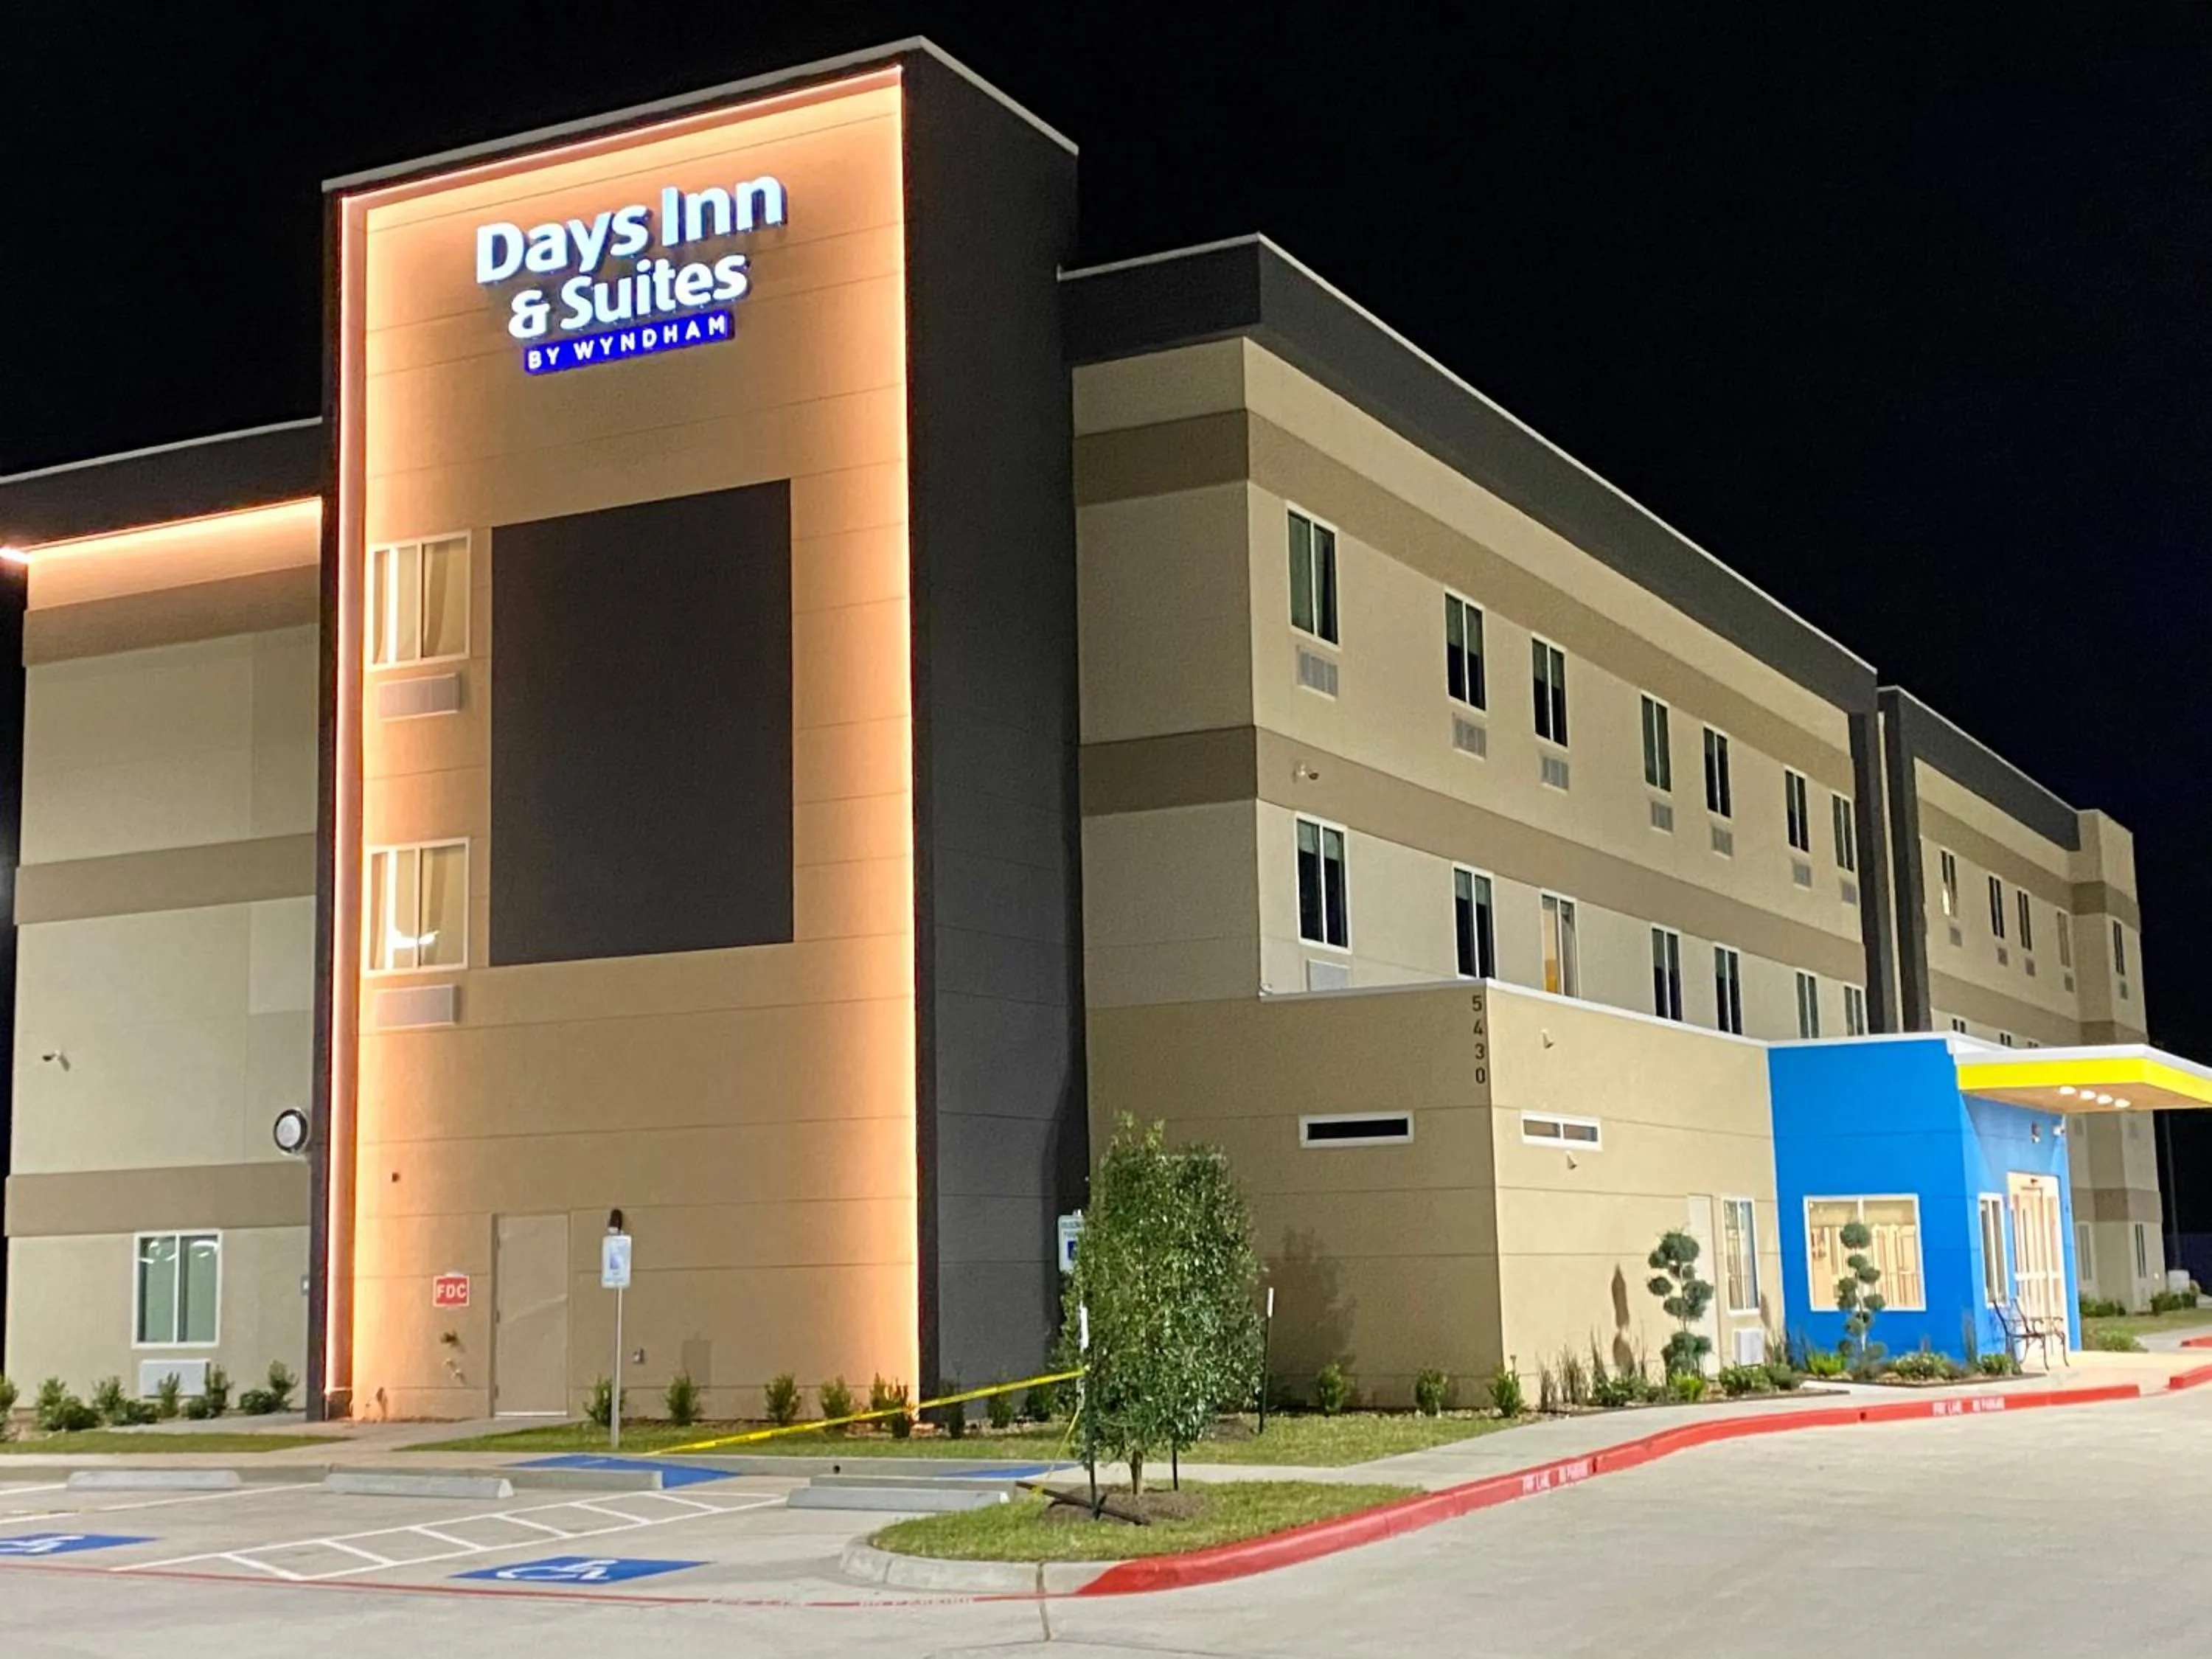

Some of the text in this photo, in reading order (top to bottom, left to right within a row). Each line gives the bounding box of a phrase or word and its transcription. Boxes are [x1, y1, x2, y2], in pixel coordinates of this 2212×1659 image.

[476, 176, 786, 284] Days Inn
[508, 254, 748, 338] & Suites
[528, 315, 726, 370] BY WYNDHAM
[1472, 995, 1486, 1084] 5430
[437, 1283, 467, 1298] FDC
